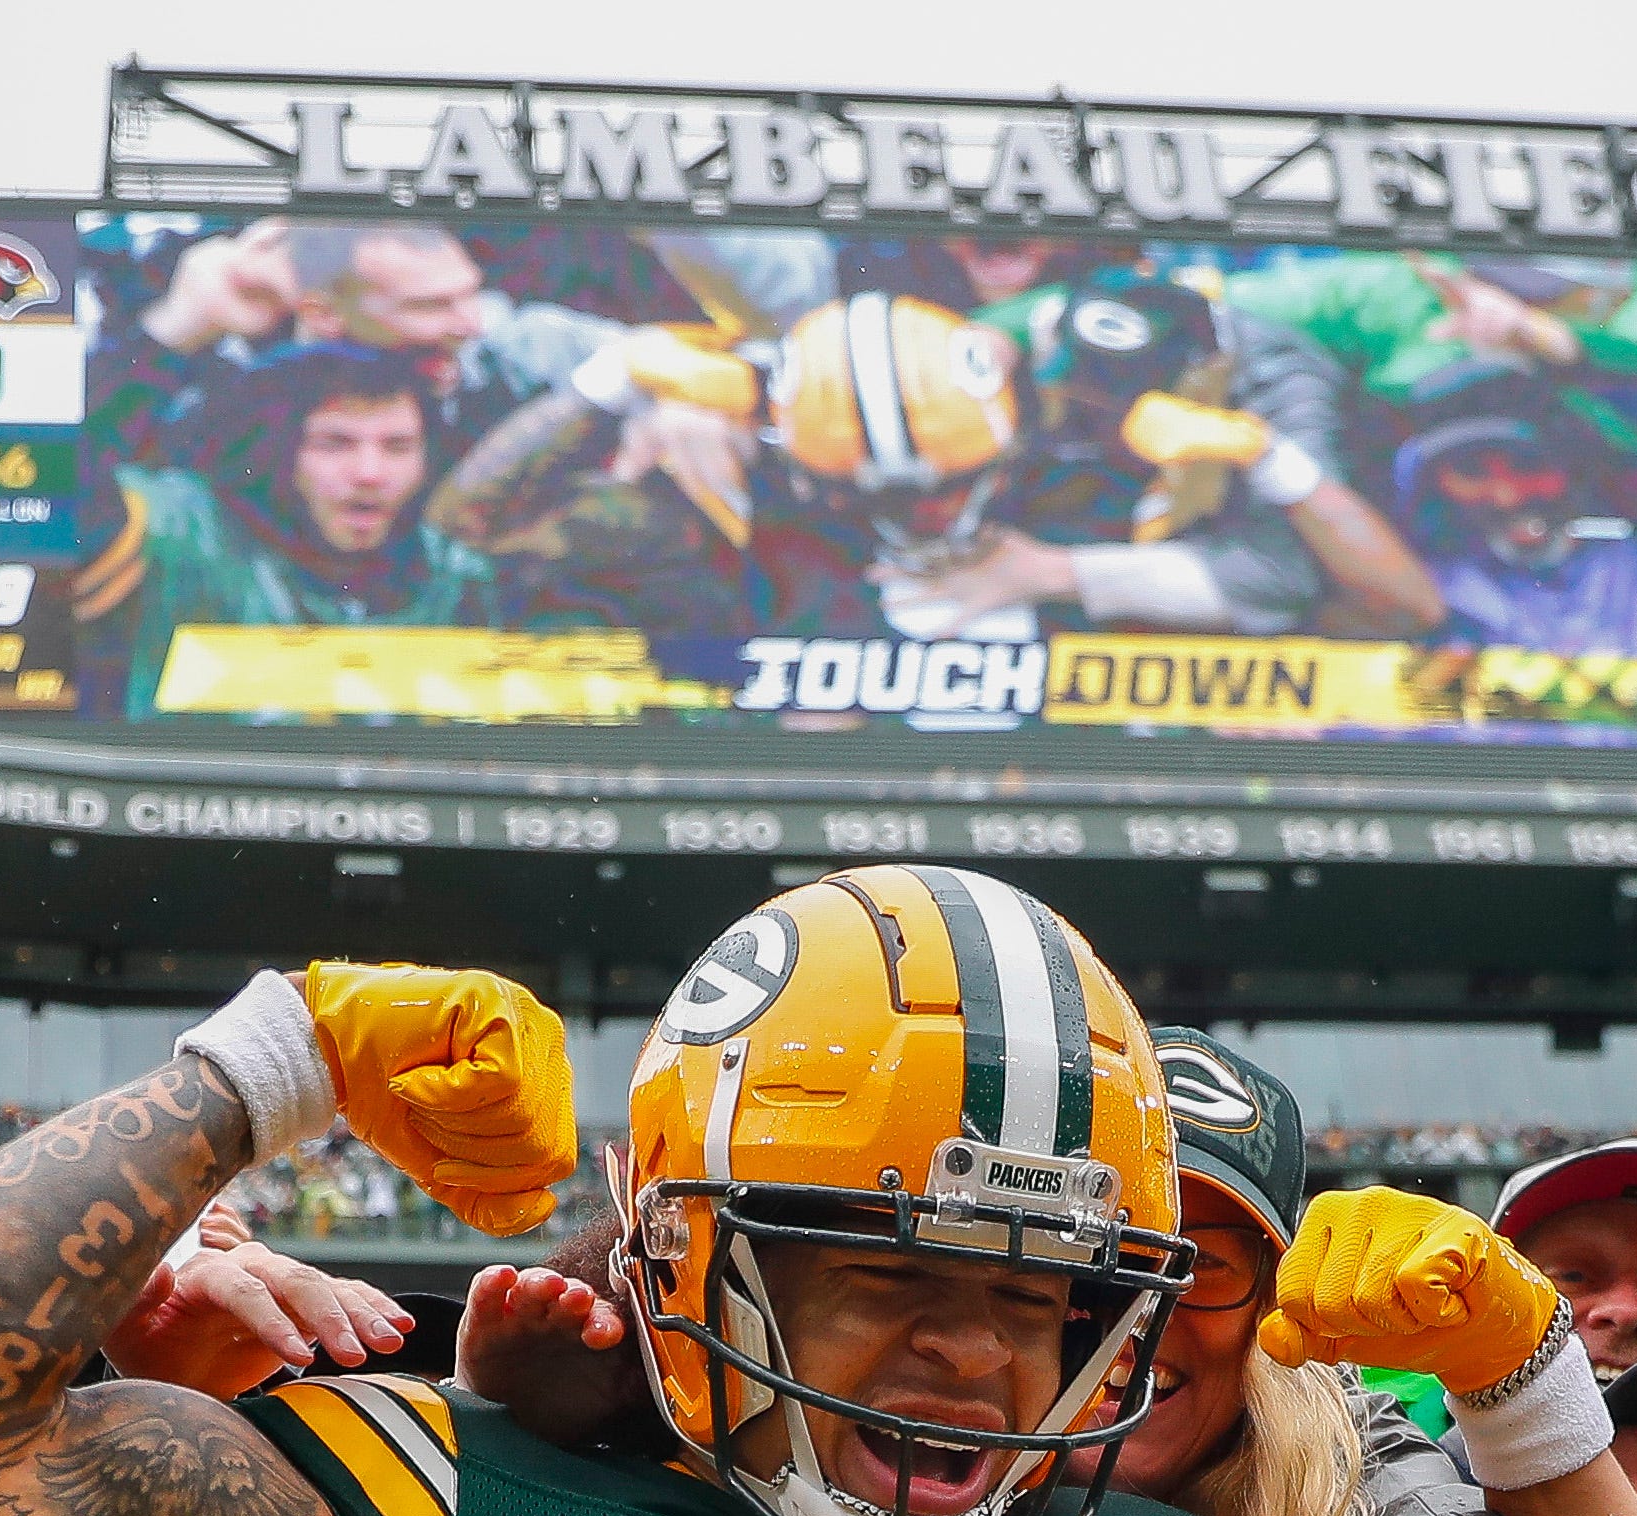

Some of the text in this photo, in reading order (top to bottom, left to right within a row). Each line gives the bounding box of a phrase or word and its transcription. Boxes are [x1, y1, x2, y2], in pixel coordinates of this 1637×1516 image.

[288, 100, 1225, 220] LAMBEAU
[734, 635, 1318, 713] TOUCH DOWN
[124, 790, 434, 843] CHAMPIONS
[503, 806, 621, 851] 1929
[664, 808, 783, 853] 1930
[823, 811, 929, 853] 1931
[969, 811, 1085, 855] 1936
[1125, 813, 1239, 857] 1939
[986, 1161, 1064, 1195] PACKERS
